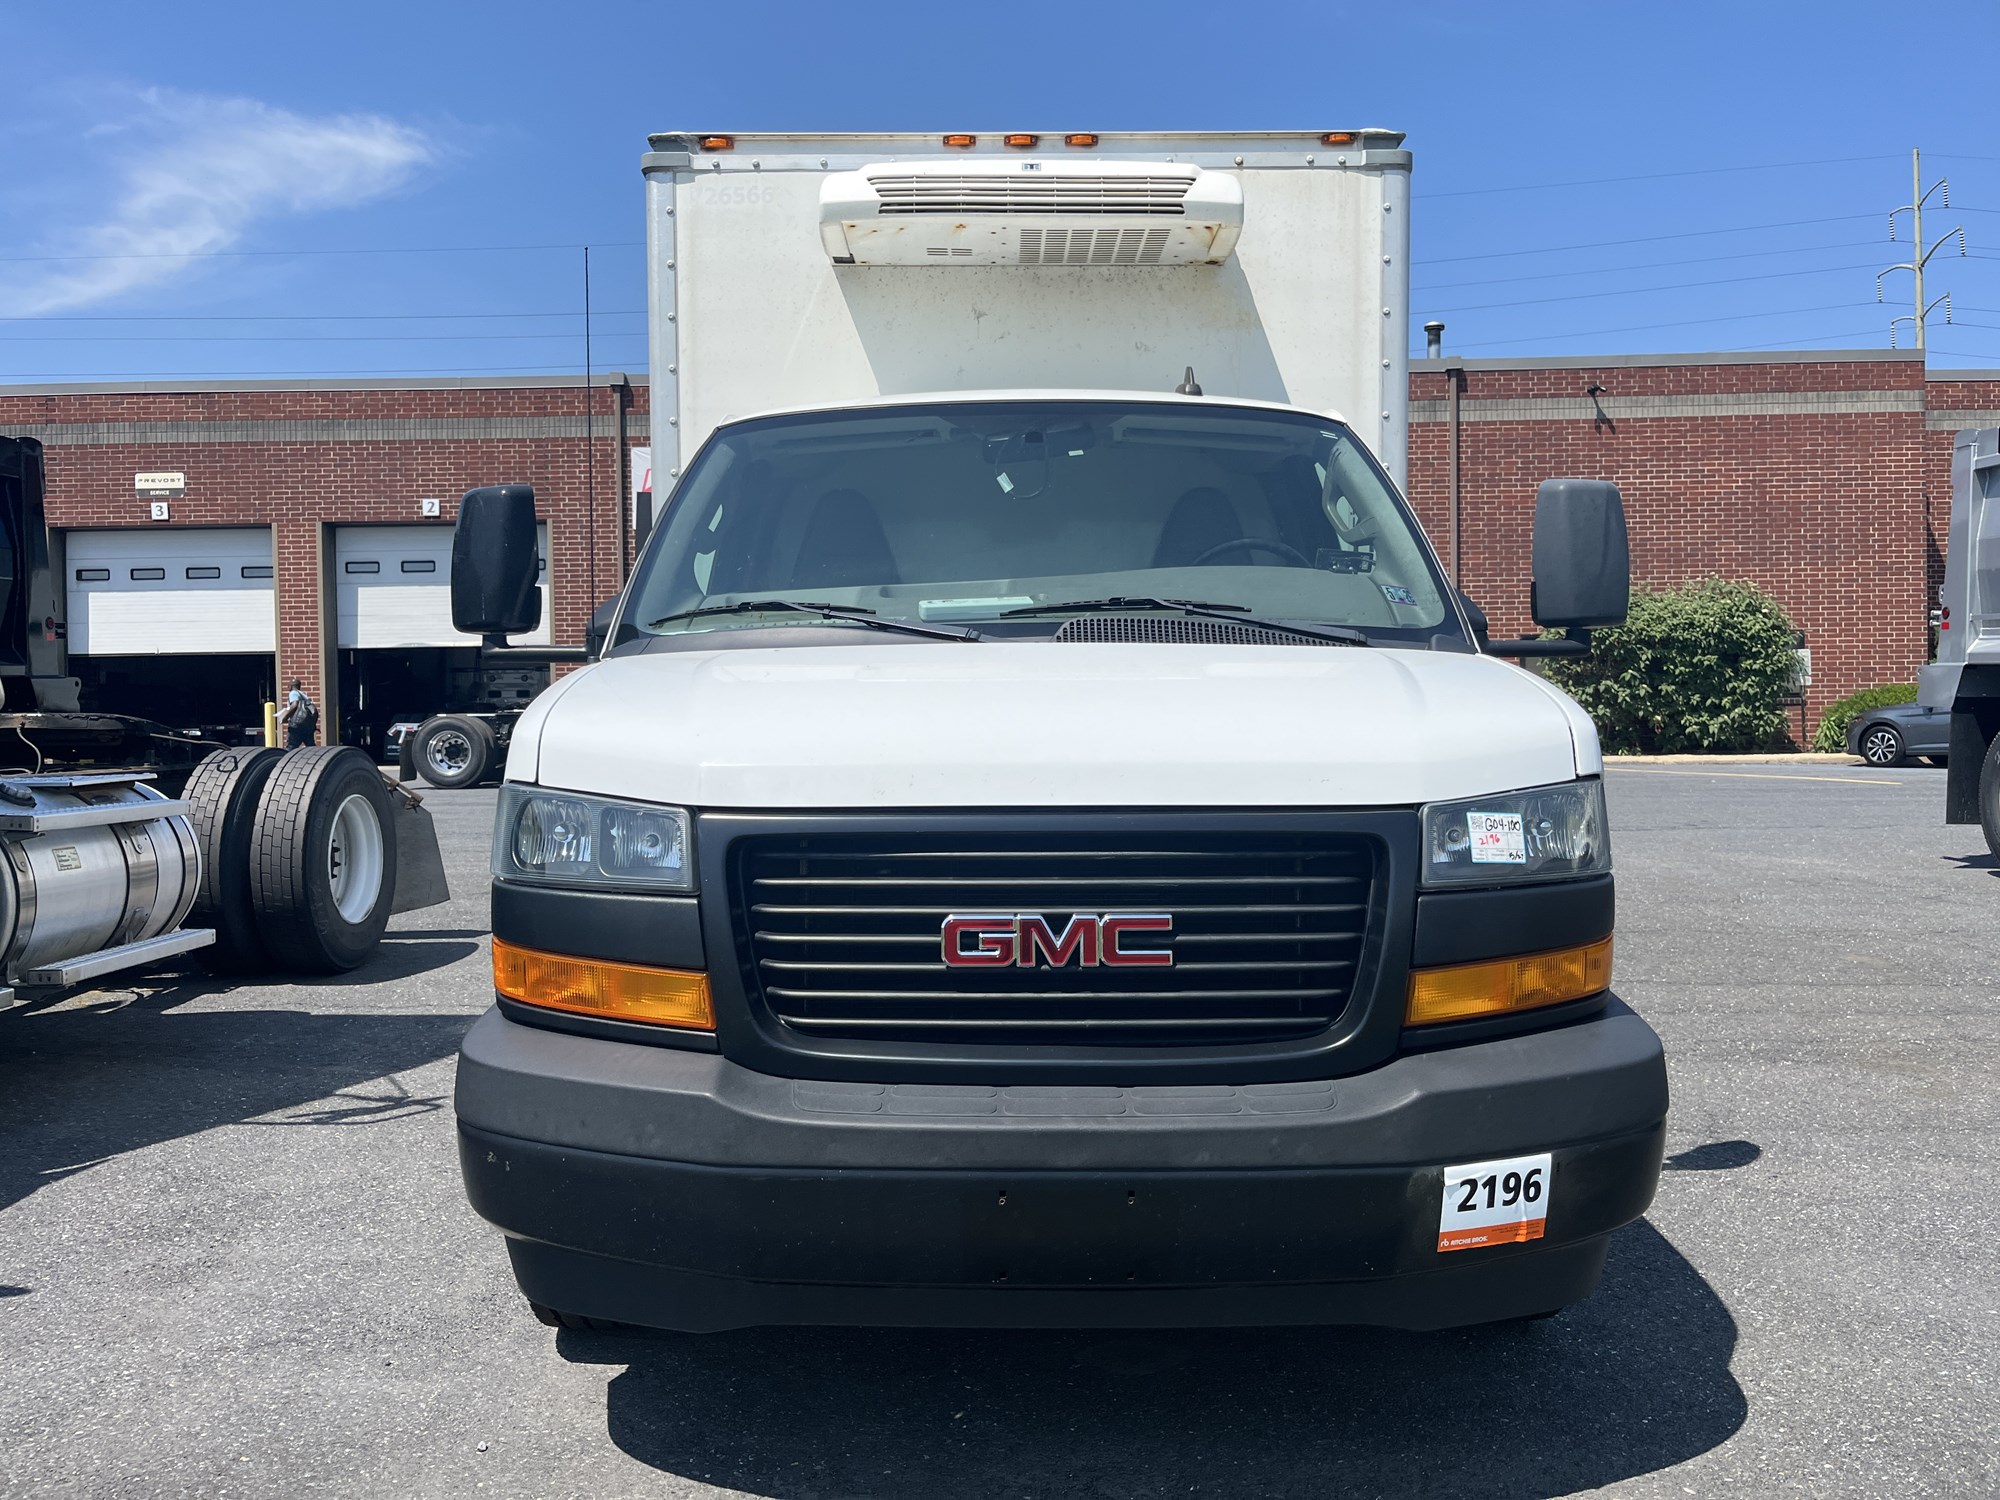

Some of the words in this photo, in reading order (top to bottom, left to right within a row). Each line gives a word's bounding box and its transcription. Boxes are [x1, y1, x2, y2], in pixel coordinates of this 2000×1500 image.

[155, 504, 164, 517] 3
[426, 501, 435, 513] 2
[1479, 834, 1501, 846] 2196
[941, 913, 1173, 967] GMC
[1457, 1168, 1542, 1213] 2196
[1450, 1237, 1471, 1246] RITCHIE
